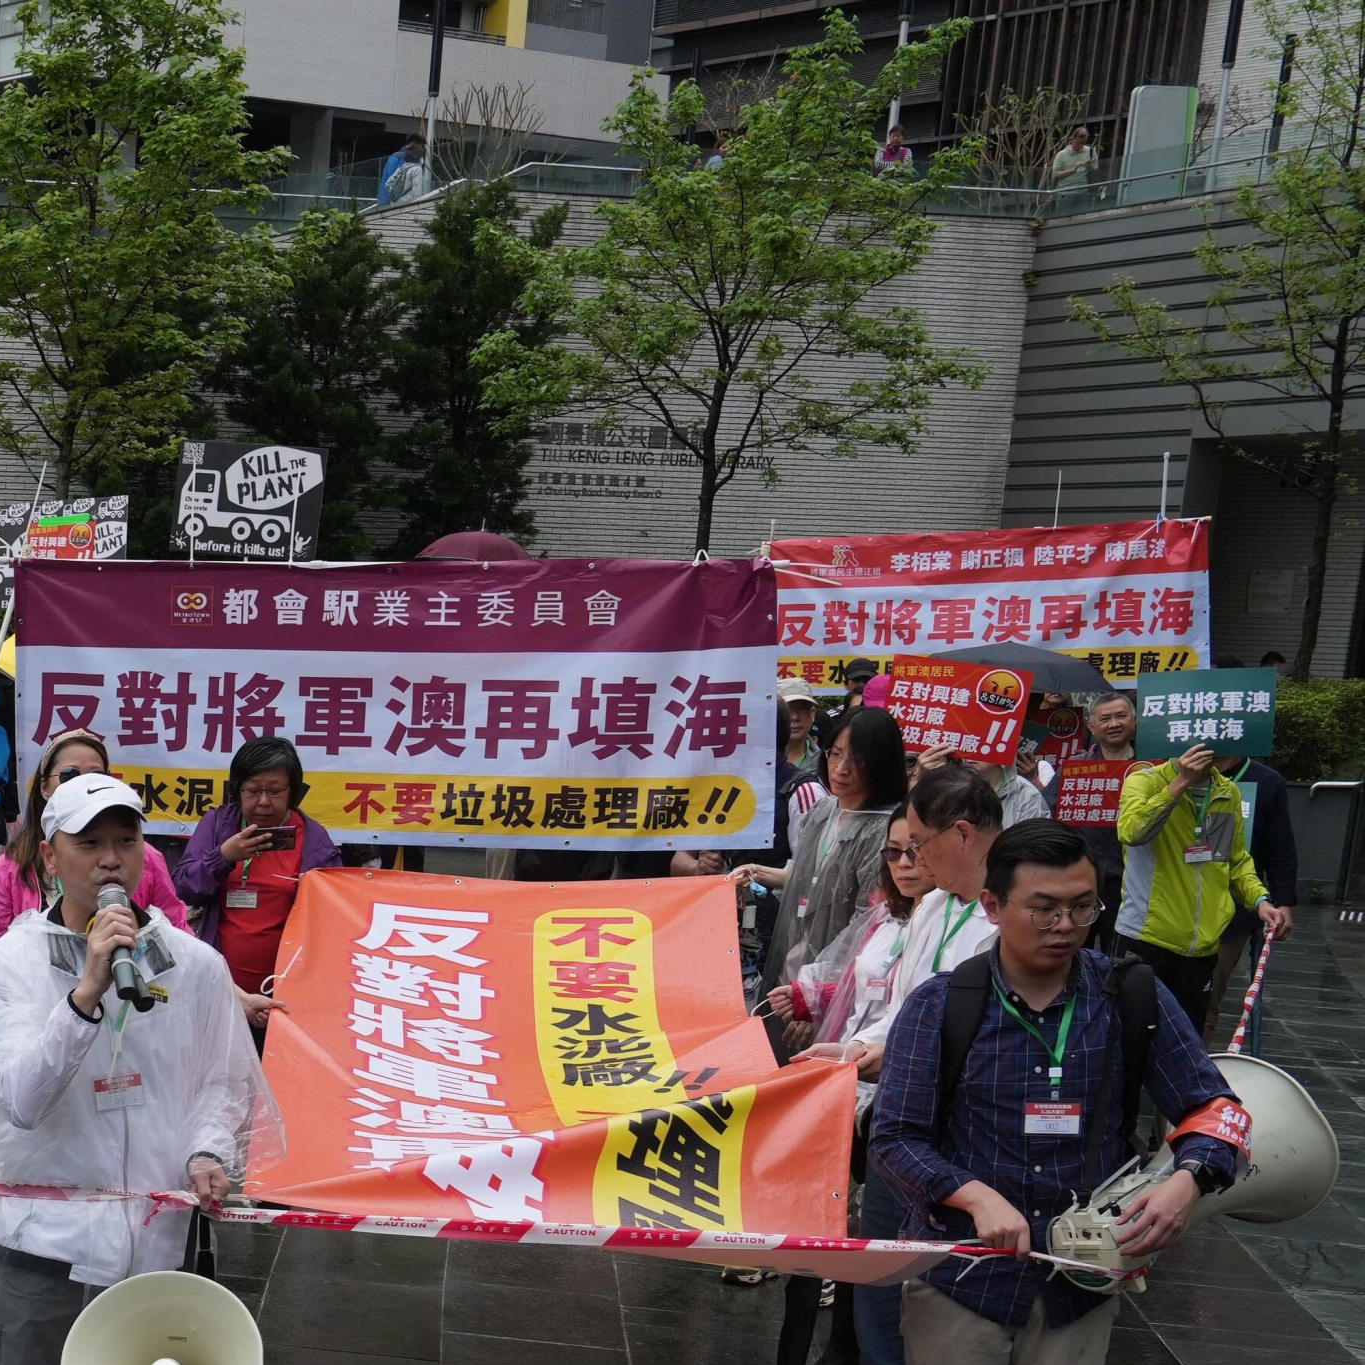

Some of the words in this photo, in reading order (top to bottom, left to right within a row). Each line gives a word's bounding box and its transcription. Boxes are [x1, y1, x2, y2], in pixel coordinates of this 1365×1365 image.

[241, 451, 288, 479] KILL
[289, 457, 307, 470] THE
[569, 449, 610, 464] KENG
[615, 450, 655, 465] LENG
[660, 452, 704, 467] PUBLI
[237, 472, 306, 504] PLANT
[95, 534, 124, 554] LANT
[194, 539, 231, 553] before
[233, 541, 241, 554] it
[243, 542, 266, 555] kills
[268, 546, 285, 557] us!
[1033, 543, 1097, 566] 陸平才
[222, 587, 622, 628] 都會駅業主委員會
[777, 588, 1194, 647] 反對將軍澳再填海
[893, 666, 955, 677] 將軍澳居民
[890, 680, 970, 707] 反對興建
[1141, 690, 1270, 717] 反對將軍澳
[31, 670, 748, 760] 反對將軍澳再填海
[888, 702, 947, 726] 水泥廠
[899, 725, 981, 754] 圾處理廠
[1167, 717, 1245, 742] 再填海
[1061, 778, 1121, 791] 反對興建
[1060, 794, 1104, 806] 水泥廠
[1057, 808, 1121, 822] 垃圾處理
[223, 1212, 258, 1221] UTION
[290, 1216, 341, 1225] SAFE
[375, 1219, 427, 1229] CAUTION
[461, 1224, 510, 1234] SAFE
[544, 1227, 597, 1237] CAUTION
[630, 1231, 682, 1241] SAFE
[714, 1234, 767, 1245] CAUTION
[799, 1239, 850, 1249] SAFE
